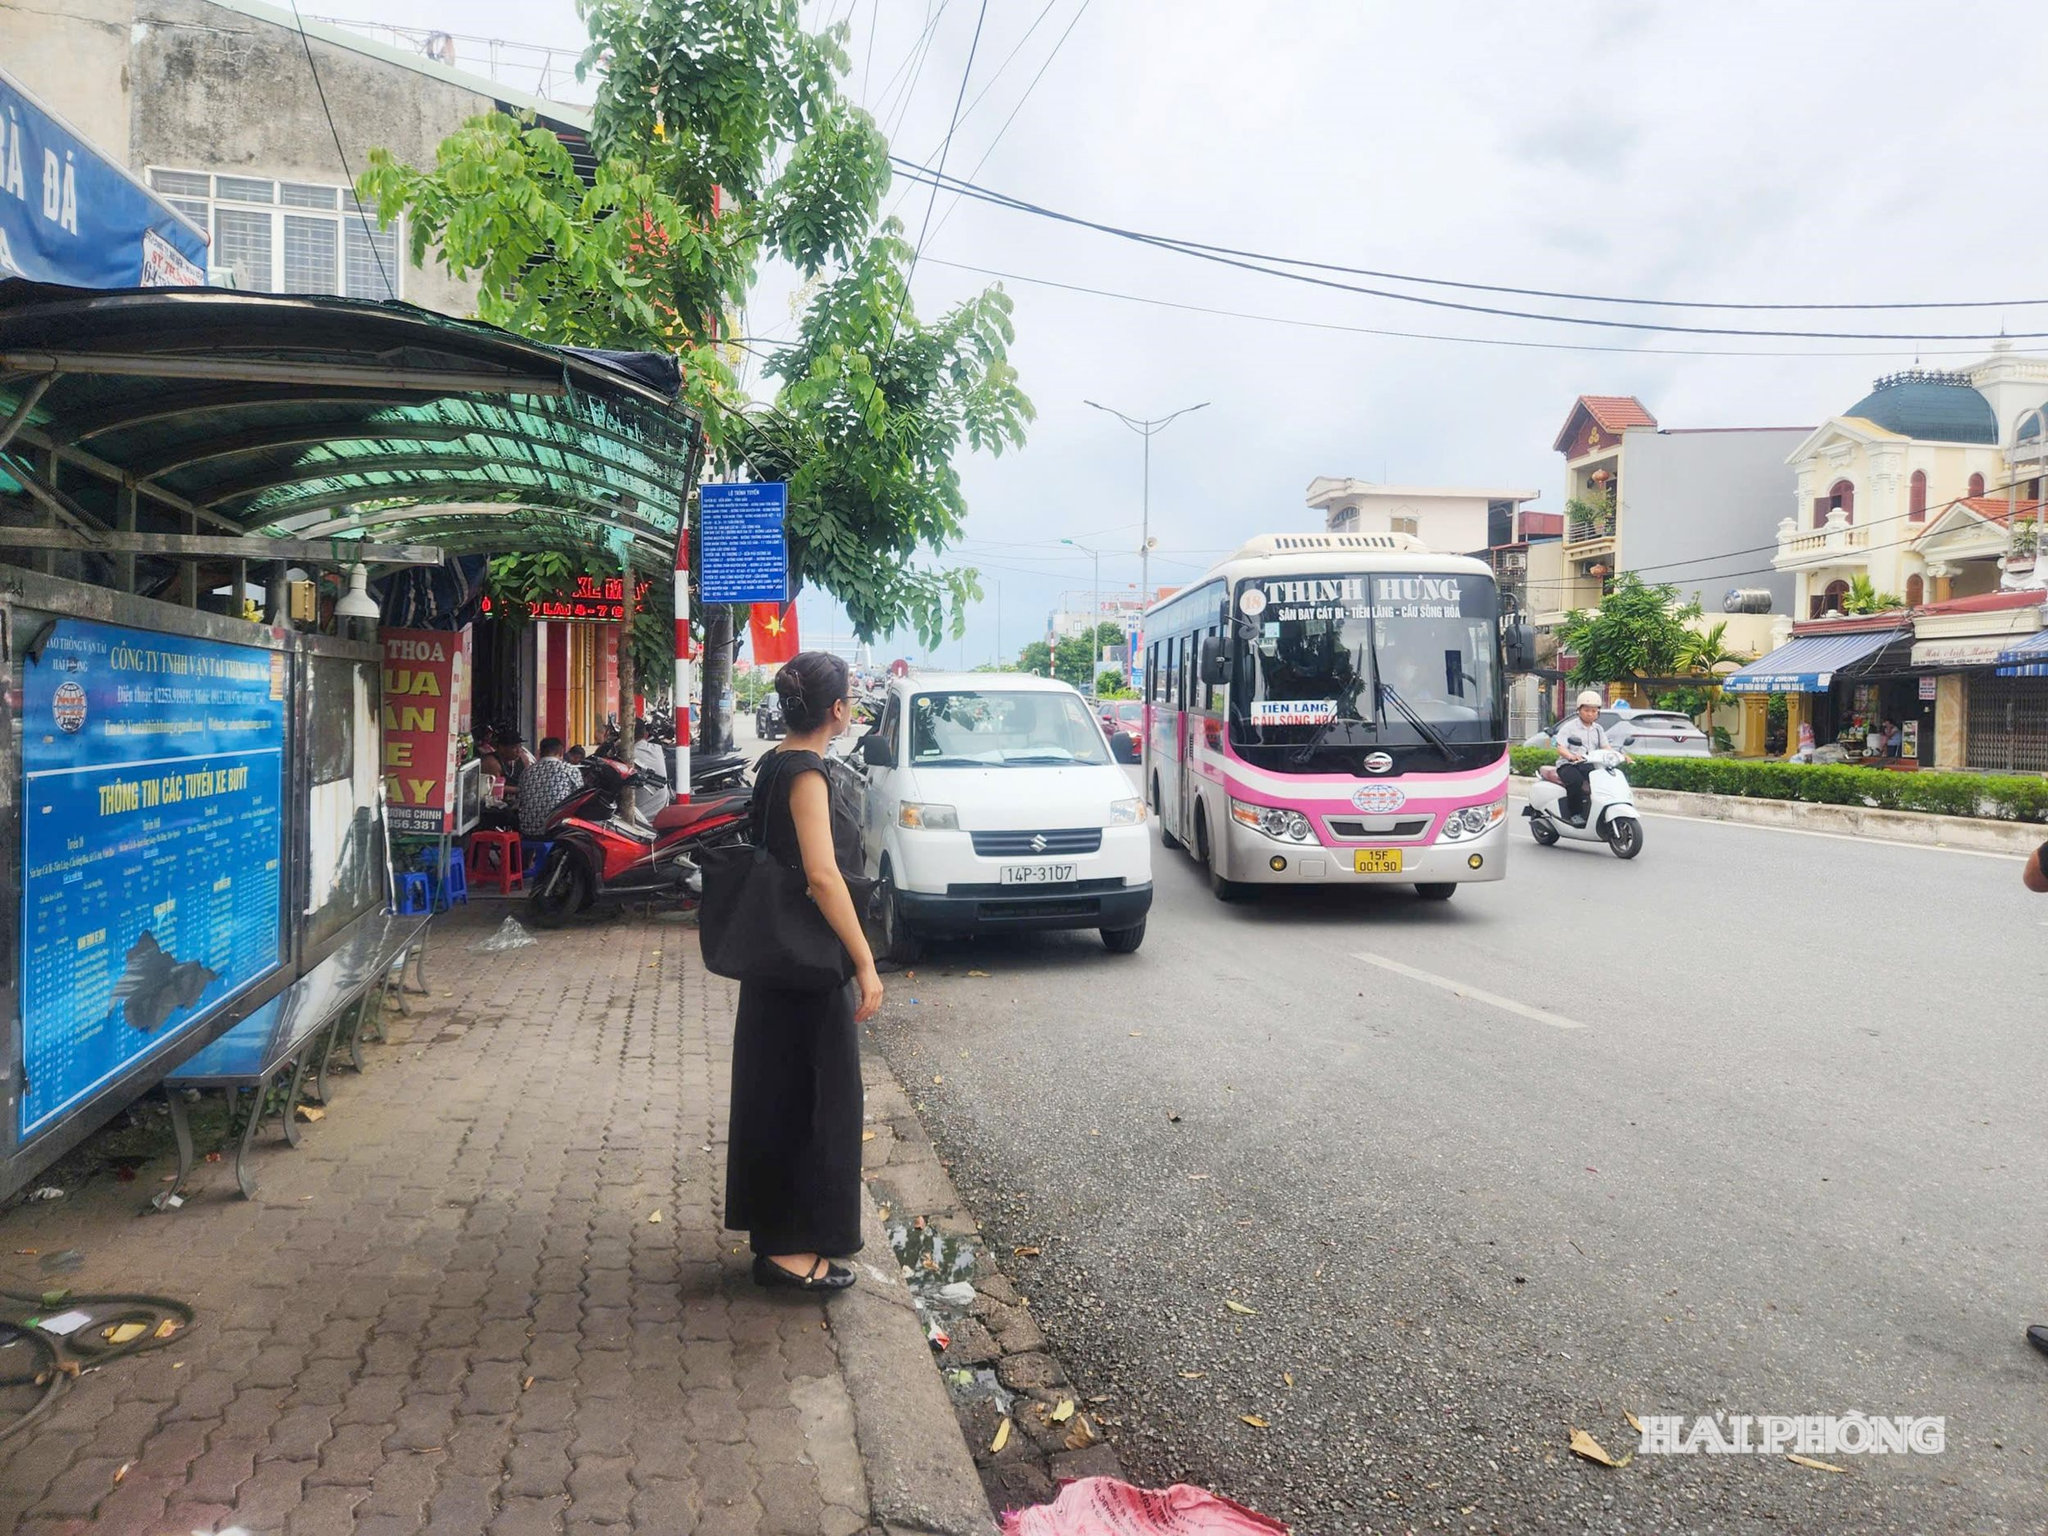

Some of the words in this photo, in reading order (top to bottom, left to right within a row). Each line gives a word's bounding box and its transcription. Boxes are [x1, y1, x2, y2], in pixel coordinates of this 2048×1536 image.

[1264, 578, 1364, 607] THỊNH
[1378, 574, 1462, 601] HƯNG
[1278, 607, 1297, 621] SÂN
[1298, 608, 1315, 620] BAY
[1316, 605, 1333, 620] CÁT
[1334, 607, 1345, 619] BI
[110, 640, 144, 672] CÔNG
[145, 650, 159, 673] TY
[161, 652, 188, 675] TNHH
[387, 640, 446, 662] THOA
[99, 777, 139, 816] THÔNG
[141, 779, 160, 808] TIN
[162, 771, 183, 804] CÁC
[185, 763, 214, 799] TUYẾN
[215, 769, 227, 795] XE
[413, 810, 443, 820] CHINH
[1369, 851, 1389, 861] 15F
[1007, 865, 1073, 883] 14P-3107
[1360, 861, 1397, 872] 001.90
